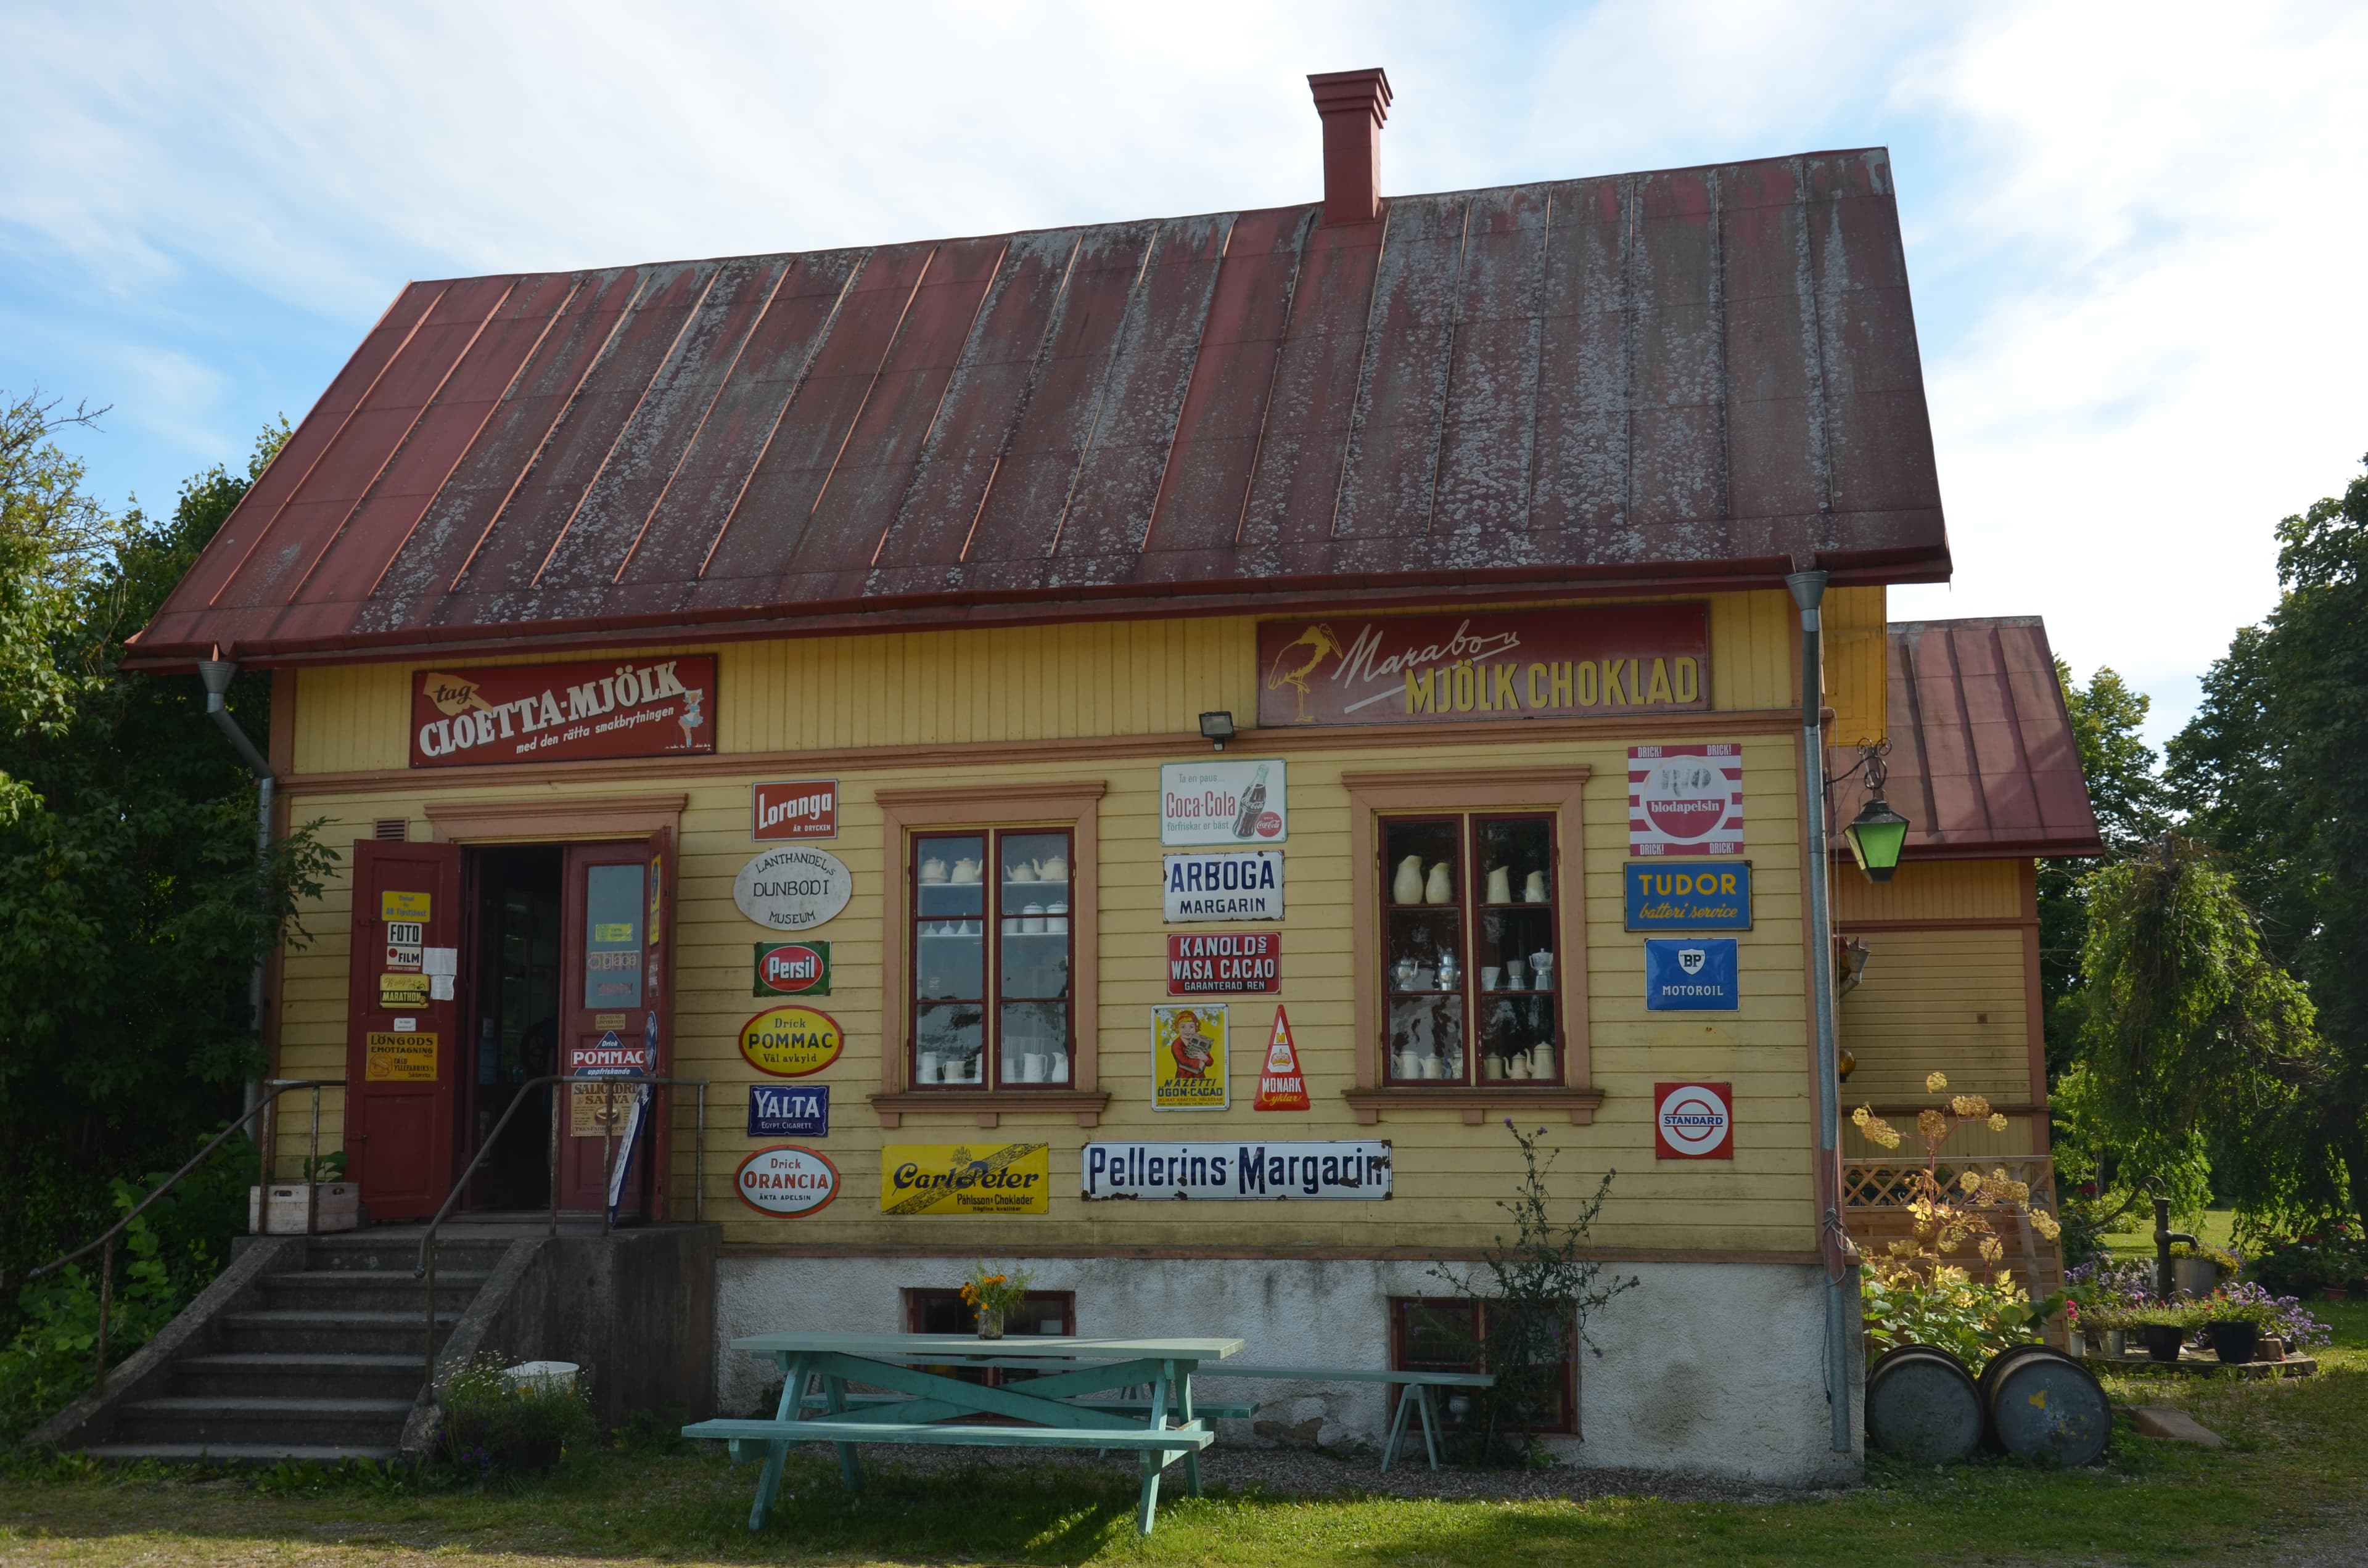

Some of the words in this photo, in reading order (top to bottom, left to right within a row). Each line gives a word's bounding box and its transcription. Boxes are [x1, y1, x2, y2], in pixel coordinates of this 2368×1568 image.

[1331, 618, 1521, 689] Marabou
[1405, 660, 1520, 714] MJÖLK
[1527, 656, 1699, 709] CHOKLAD
[432, 683, 472, 705] tag
[516, 740, 536, 754] med
[540, 733, 559, 747] den
[563, 725, 590, 742] rätta
[594, 705, 674, 734] smakbrytningen
[1638, 746, 1662, 758] DRICK!
[1707, 744, 1732, 756] DRICK!
[1178, 773, 1186, 783] Ta
[759, 793, 832, 829] Loranga
[1166, 790, 1236, 818] Coca-Cola
[1651, 800, 1720, 814] blodapelsin
[793, 824, 802, 832] ÄR
[1167, 821, 1201, 832] förfriskar
[1213, 820, 1229, 830] bäst
[1640, 844, 1664, 855] DRICK!
[1709, 842, 1734, 854] DRICK!
[1170, 861, 1275, 893] ARBOGA
[1638, 873, 1737, 895] TUDOR
[1180, 898, 1265, 914] MARGARIN
[1639, 902, 1689, 919] batteri
[1688, 902, 1738, 918] service
[768, 909, 816, 924] MUSEUM
[390, 924, 419, 942] FOTO
[398, 953, 419, 963] FILM
[602, 952, 637, 969] glace
[769, 956, 815, 982] Persil
[1172, 959, 1214, 980] WASA
[1220, 959, 1275, 979] CACAO
[1185, 981, 1243, 991] GARANTERAD
[1247, 981, 1265, 990] REN
[1662, 985, 1724, 996] MOTOROIL
[382, 991, 421, 1002] MARATHON
[775, 1018, 806, 1028] Drick
[371, 1034, 434, 1046] LÖNGODS
[749, 1033, 833, 1049] POMMAC
[1276, 1032, 1286, 1043] M
[573, 1050, 644, 1065] POMMAC
[763, 1053, 779, 1062] Väl
[783, 1053, 817, 1064] avkyld
[587, 1067, 631, 1076] uppfriskande
[1262, 1078, 1302, 1093] MONARK
[754, 1091, 820, 1118] YALTA
[1262, 1091, 1302, 1106] Cyklar
[1664, 1116, 1723, 1125] STANDARD
[770, 1158, 801, 1169] Drick
[1089, 1146, 1227, 1194] Pellerins
[1239, 1146, 1383, 1194] Margarin
[744, 1171, 829, 1189] ORANCIA
[892, 1162, 956, 1196] Carl
[994, 1194, 1035, 1205] Choklader
